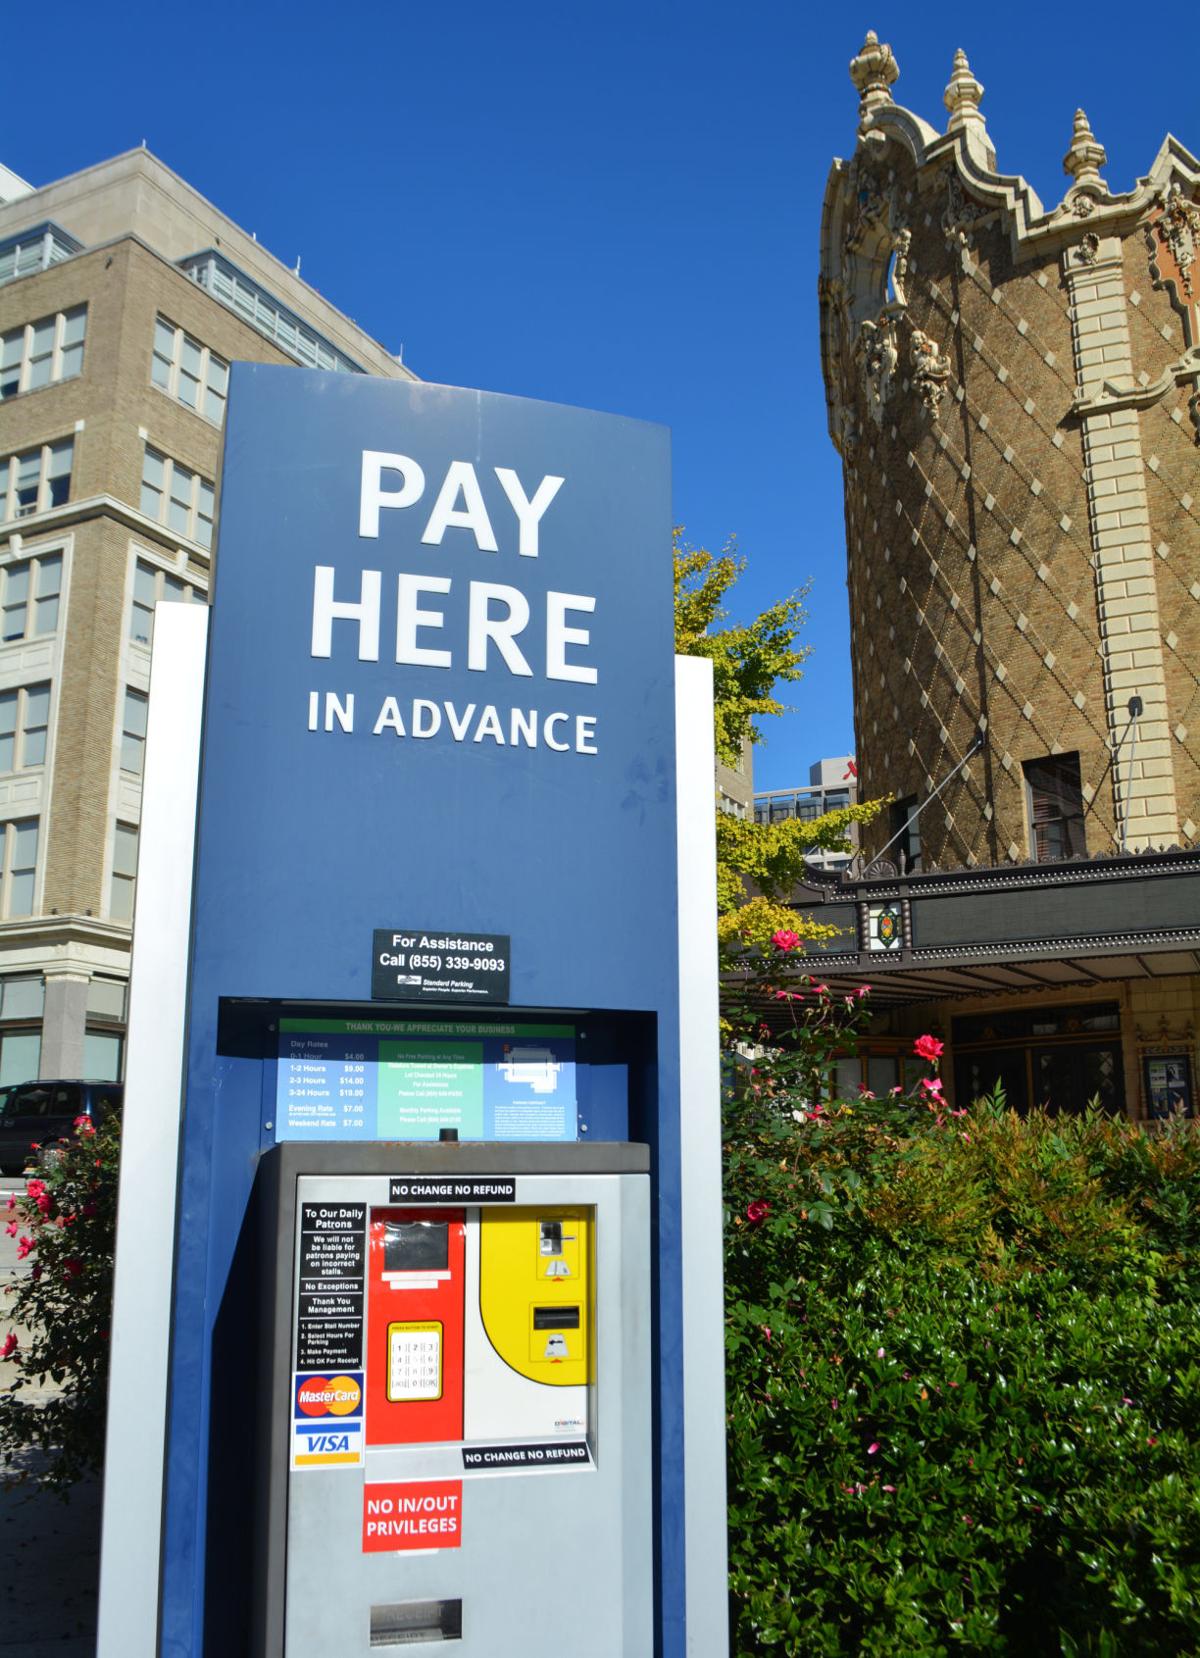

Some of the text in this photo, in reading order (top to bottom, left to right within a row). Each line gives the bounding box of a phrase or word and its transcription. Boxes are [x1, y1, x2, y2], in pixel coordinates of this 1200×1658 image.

[359, 450, 566, 558] PAY
[311, 565, 598, 685] HERE
[308, 691, 599, 755] IN ADVANCE
[392, 934, 494, 952] For Assistance
[379, 953, 505, 972] Call (855) 339-9093
[423, 979, 450, 987] Standard
[451, 980, 474, 989] Parking
[346, 1023, 374, 1031] THANK
[406, 1024, 454, 1033] APPRECIATE
[455, 1025, 477, 1033] YOUR
[478, 1026, 516, 1034] BUSINESS
[290, 1040, 306, 1049] Day
[303, 1065, 327, 1073] Hours
[344, 1065, 365, 1073] $9.00
[303, 1077, 327, 1085] Hours
[307, 1089, 330, 1097] Hours
[289, 1104, 317, 1113] Evening
[343, 1104, 364, 1113] $7.00
[392, 1185, 513, 1195] NO CHANGE NO REFUND
[305, 1209, 364, 1220] To Our Daily
[315, 1220, 353, 1229] Patrons
[344, 1243, 356, 1251] for
[305, 1252, 360, 1261] patrons paying
[322, 1260, 356, 1268] incorrect
[321, 1268, 344, 1276] stalls.
[318, 1282, 359, 1291] Exceptions
[312, 1297, 351, 1306] Thank You
[308, 1306, 355, 1315] Management
[299, 1390, 359, 1403] MasterCard
[307, 1435, 350, 1453] VISA
[465, 1448, 586, 1463] NO CHANGE NO REFUND
[367, 1496, 458, 1515] NO IN/OUT
[367, 1517, 458, 1537] PRIVILEGES
